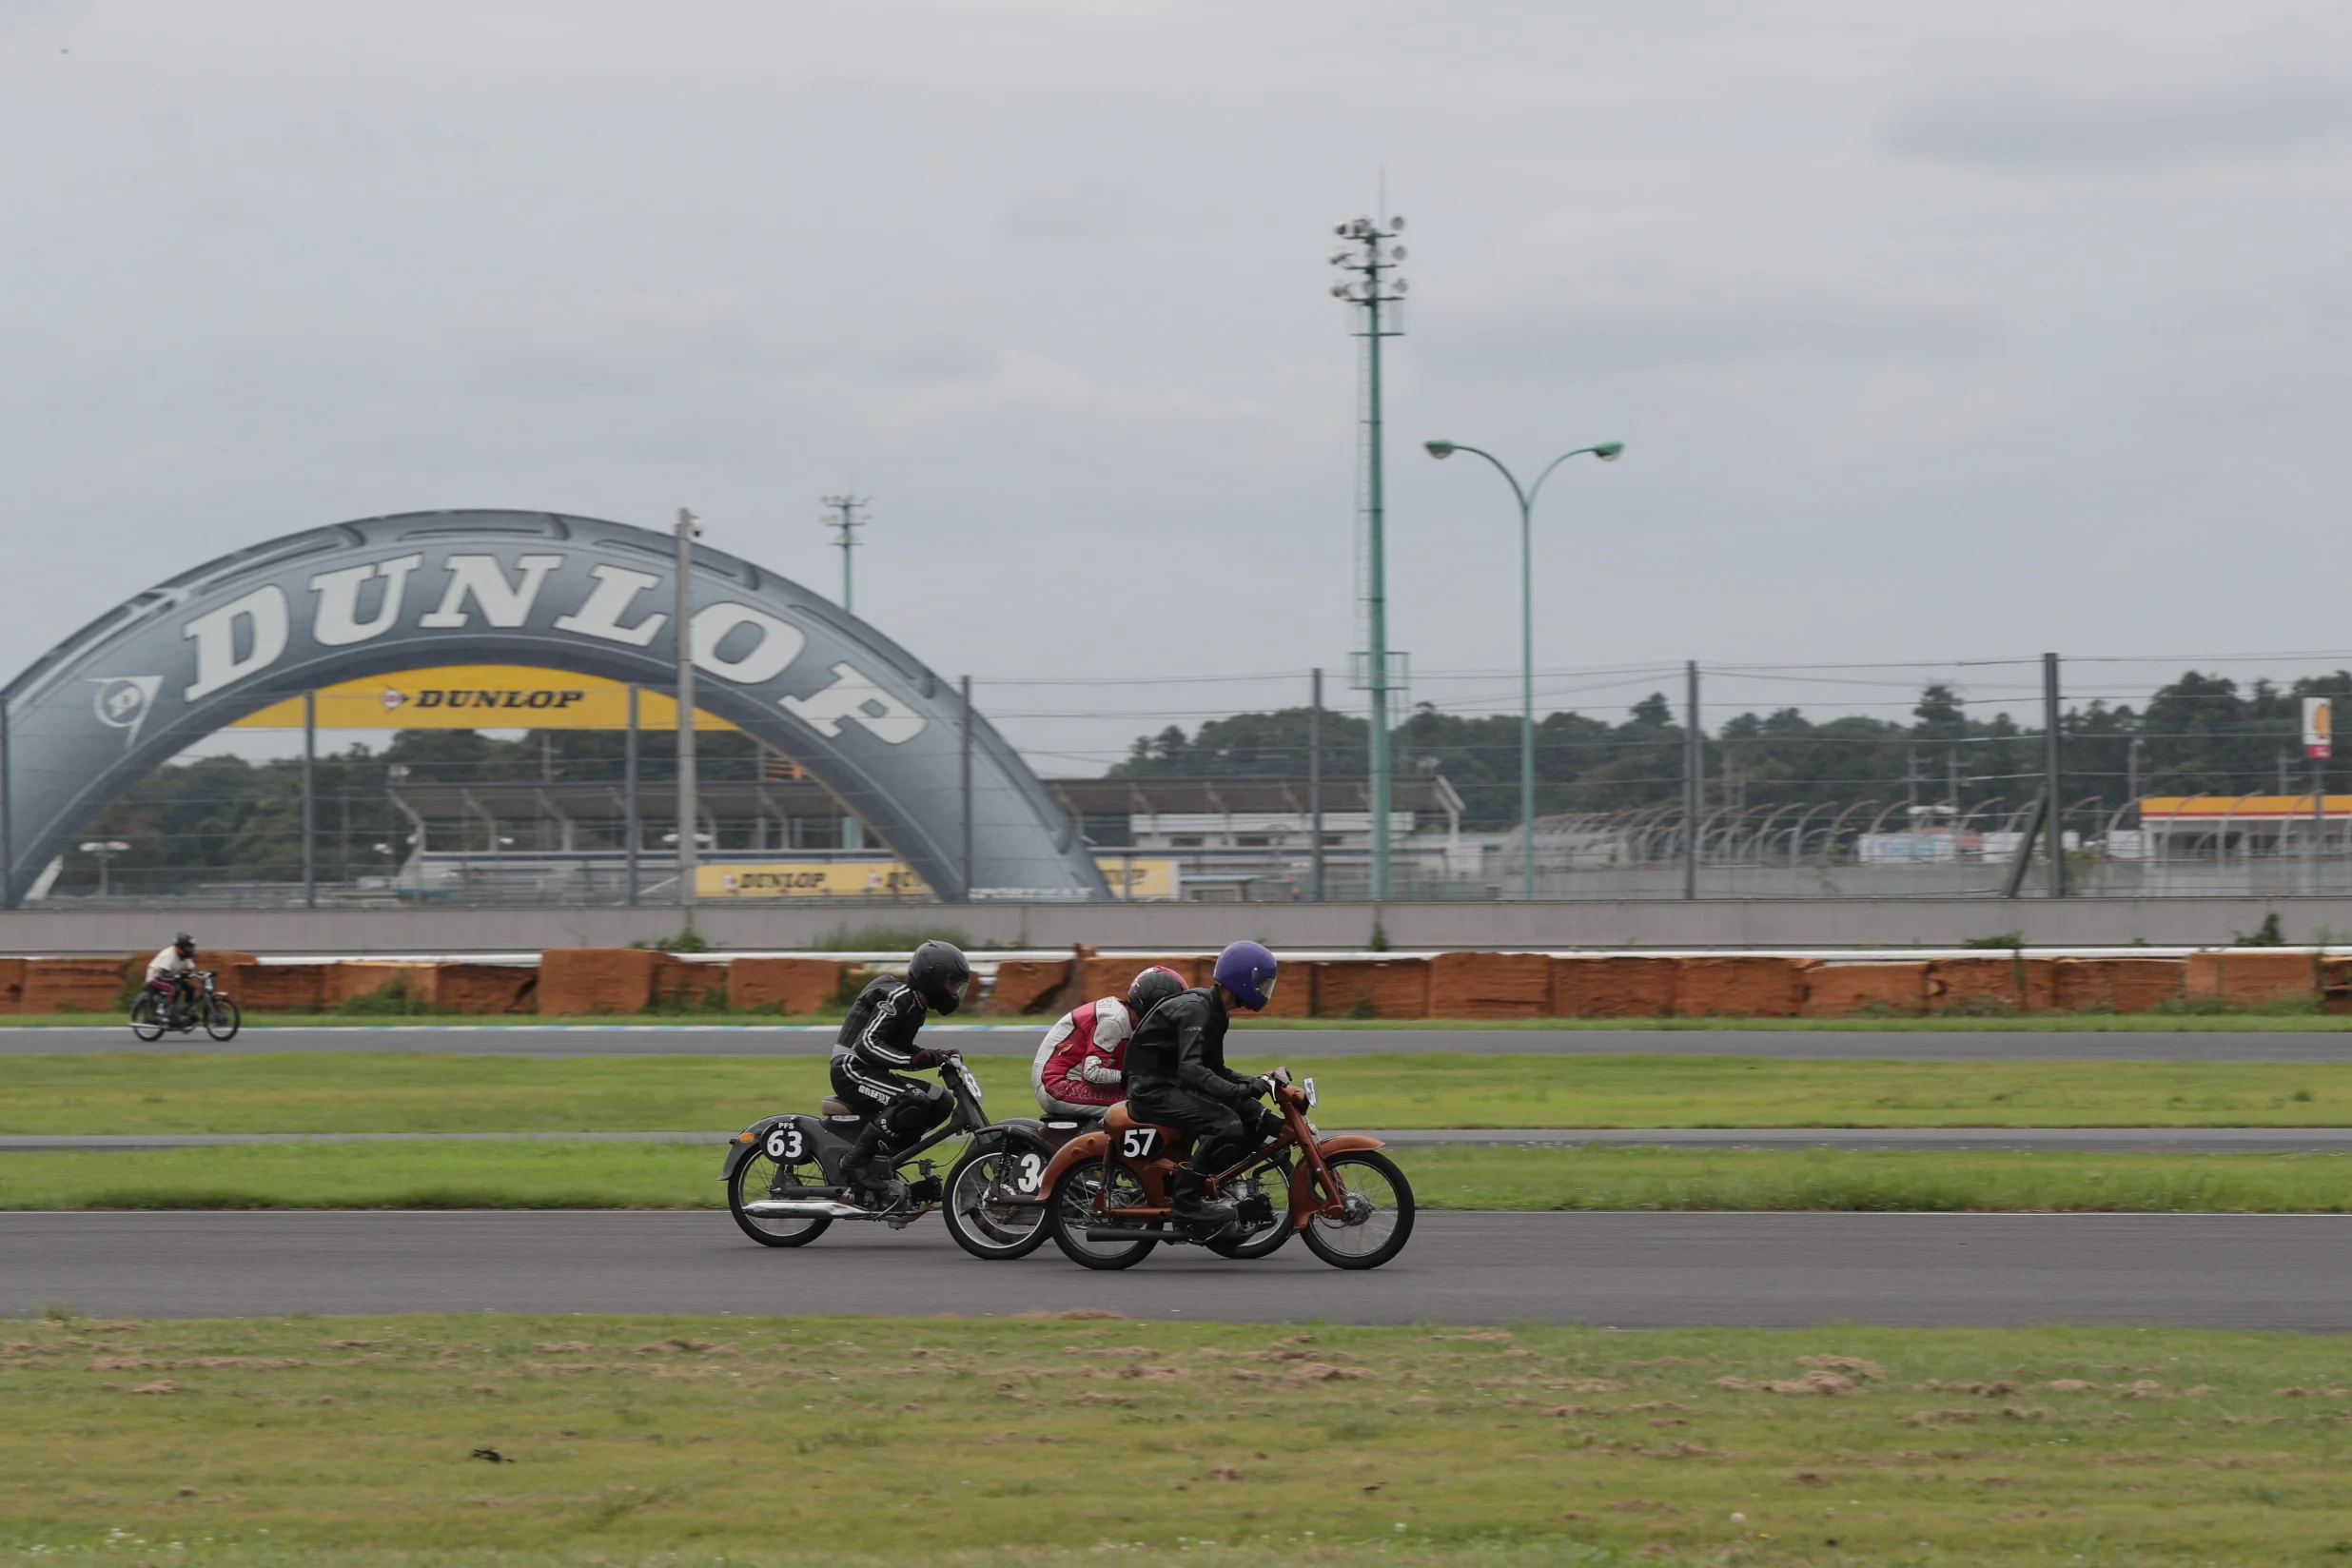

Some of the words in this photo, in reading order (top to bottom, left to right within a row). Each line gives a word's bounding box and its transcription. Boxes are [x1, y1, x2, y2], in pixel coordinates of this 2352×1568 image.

[183, 553, 929, 745] DUNLOP
[414, 690, 584, 708] DUNLOP
[739, 872, 827, 889] DUNLOP
[767, 1129, 802, 1158] 63
[1123, 1127, 1156, 1158] 57
[1017, 1153, 1047, 1193] 3
